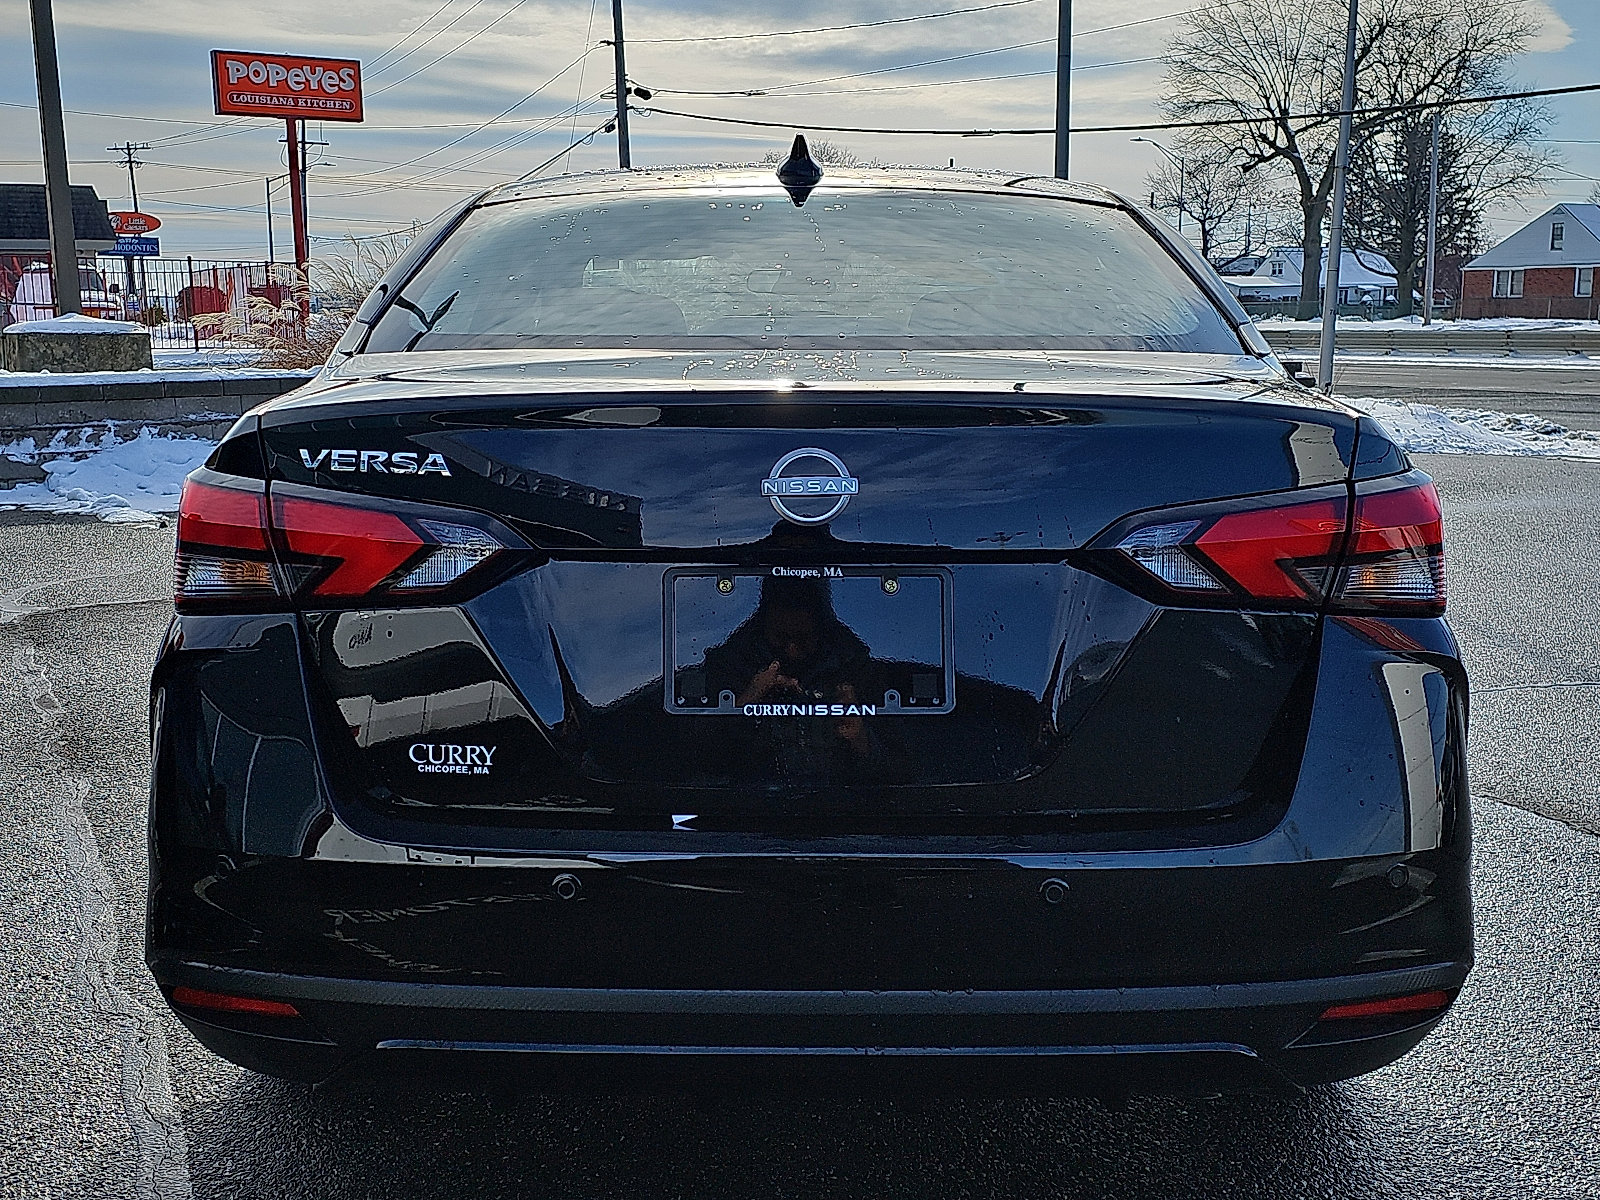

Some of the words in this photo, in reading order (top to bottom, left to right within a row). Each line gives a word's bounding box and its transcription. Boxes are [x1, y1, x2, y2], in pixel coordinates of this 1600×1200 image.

[232, 94, 294, 106] LOUISIANA
[297, 98, 351, 109] KITCHEN
[128, 217, 146, 225] Little
[299, 448, 452, 477] VERSA
[763, 480, 856, 494] NISSAN
[772, 566, 821, 578] Chicopee,
[823, 567, 843, 577] MA
[408, 743, 497, 766] CURRY
[417, 764, 472, 775] CHICOPEE,
[473, 766, 490, 775] MA
